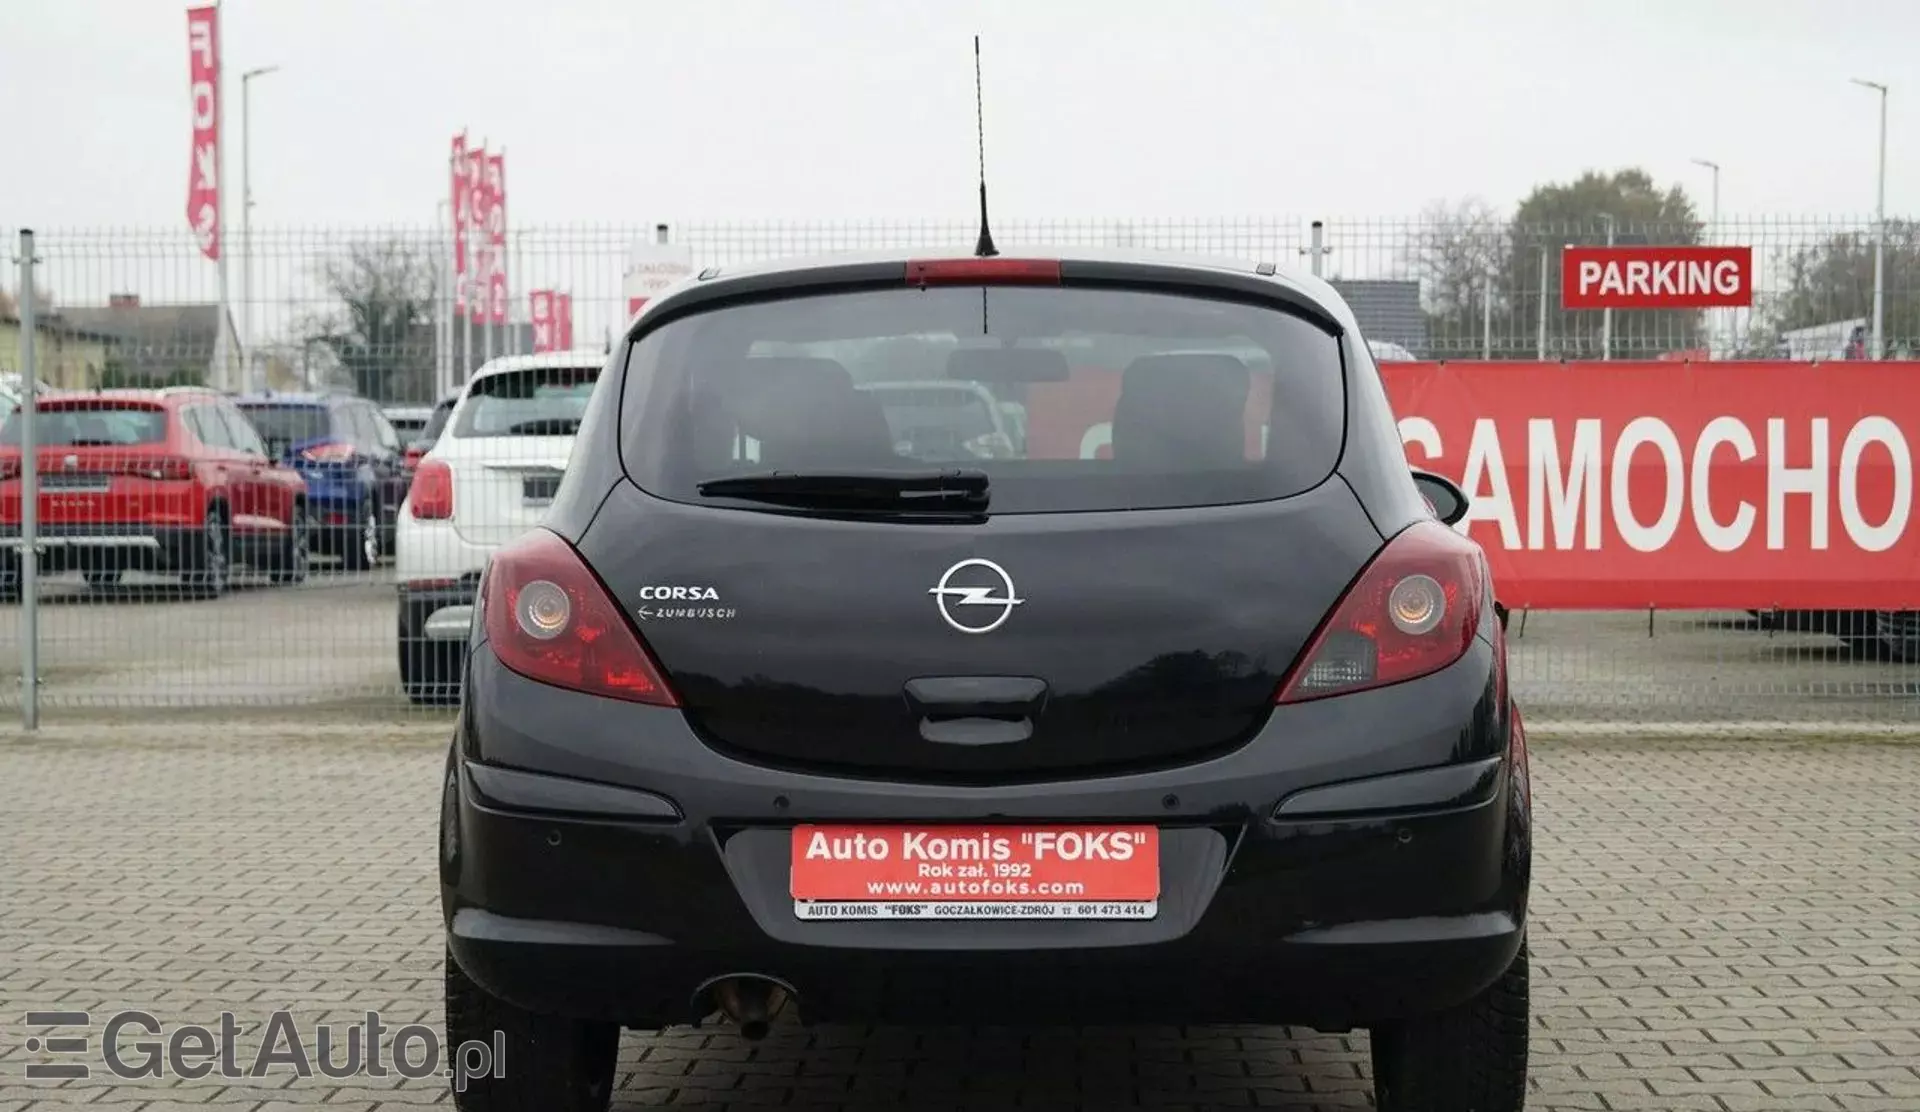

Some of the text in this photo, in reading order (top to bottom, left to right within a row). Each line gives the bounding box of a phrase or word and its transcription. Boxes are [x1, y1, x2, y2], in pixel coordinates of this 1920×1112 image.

[1579, 259, 1740, 296] PARKING
[640, 586, 719, 600] CORSA
[656, 607, 736, 618] ZUMBUSCH
[805, 831, 1146, 861] Auto Komis "FOKS"
[918, 862, 1032, 878] Rok zał. 1992
[867, 879, 1085, 895] www.autofoks.com
[807, 905, 838, 916] AUTO
[841, 905, 878, 916] KOMIS
[934, 903, 1055, 916] GOCZAŁKOWICE-ZDRÓJ
[1078, 905, 1098, 915] 601
[1101, 905, 1122, 915] 473
[1125, 905, 1145, 915] 414
